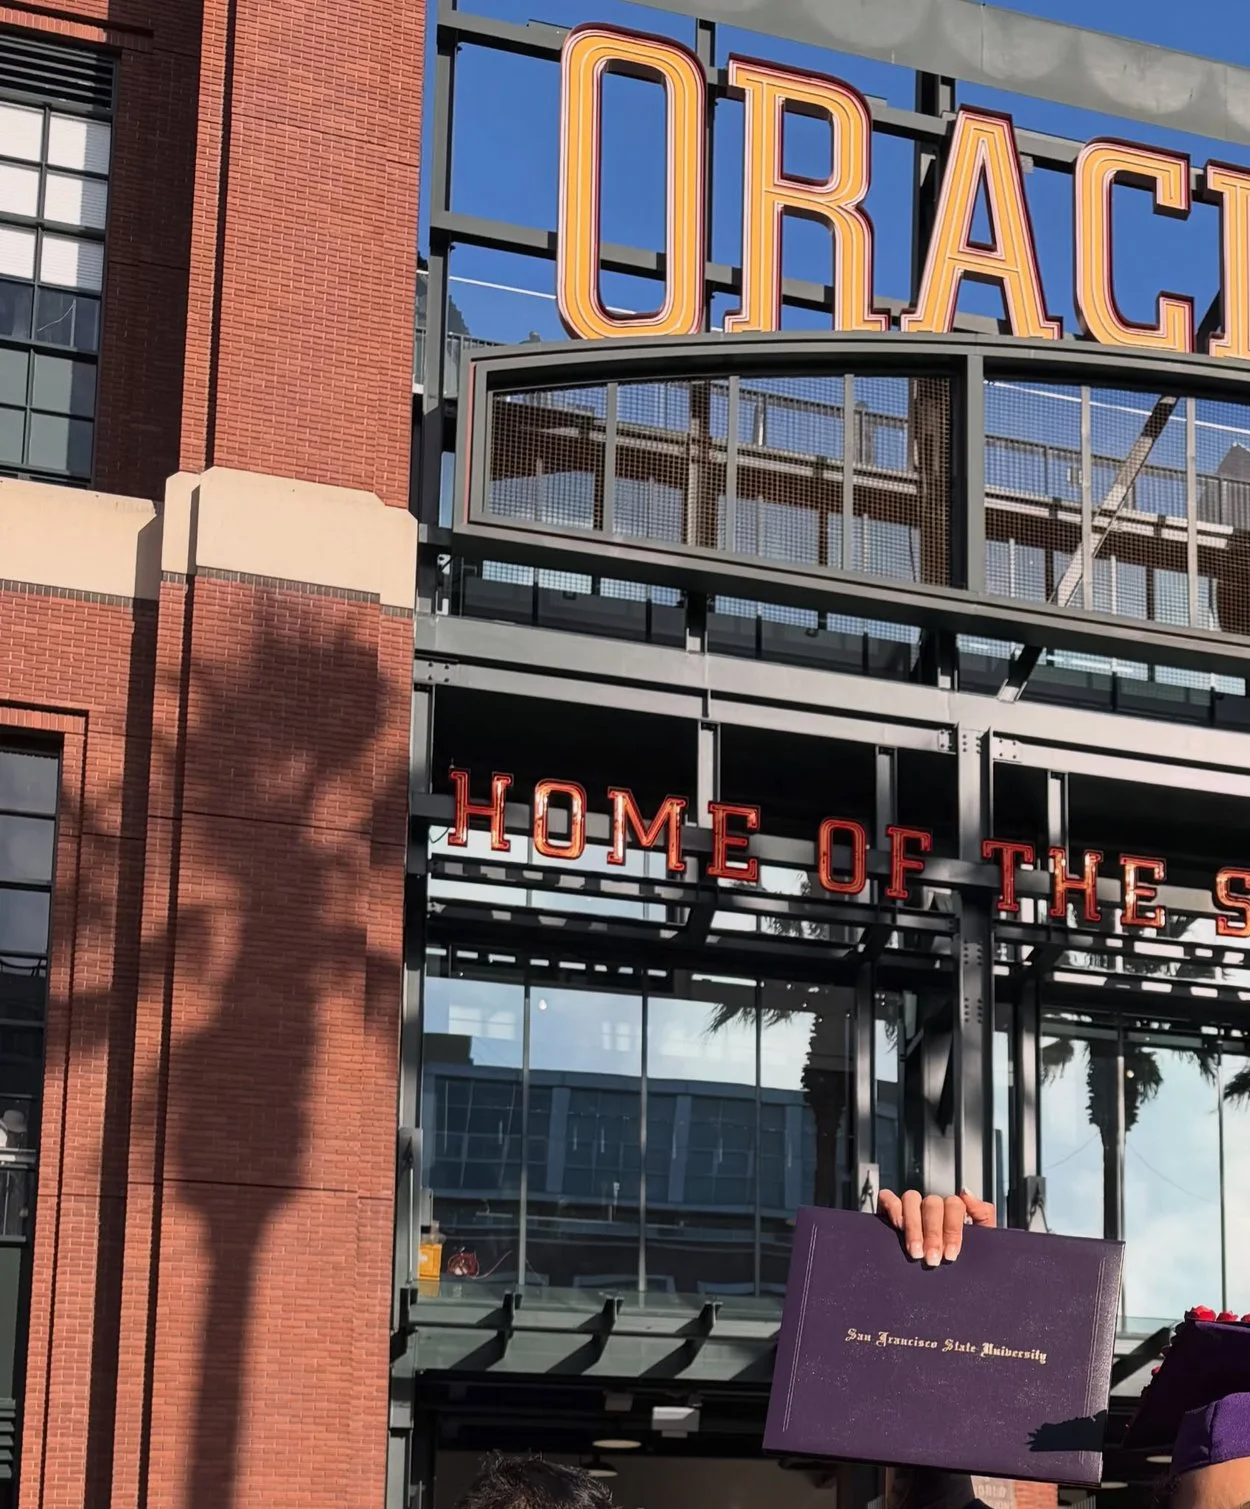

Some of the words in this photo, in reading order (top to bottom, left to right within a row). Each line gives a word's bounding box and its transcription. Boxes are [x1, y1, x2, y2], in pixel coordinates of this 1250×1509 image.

[447, 766, 761, 883] HOME
[816, 815, 934, 900] OF
[981, 838, 1168, 929] THE
[845, 1327, 872, 1343] San
[876, 1330, 938, 1349] Francisco
[942, 1337, 977, 1354] State
[980, 1341, 1048, 1365] University
